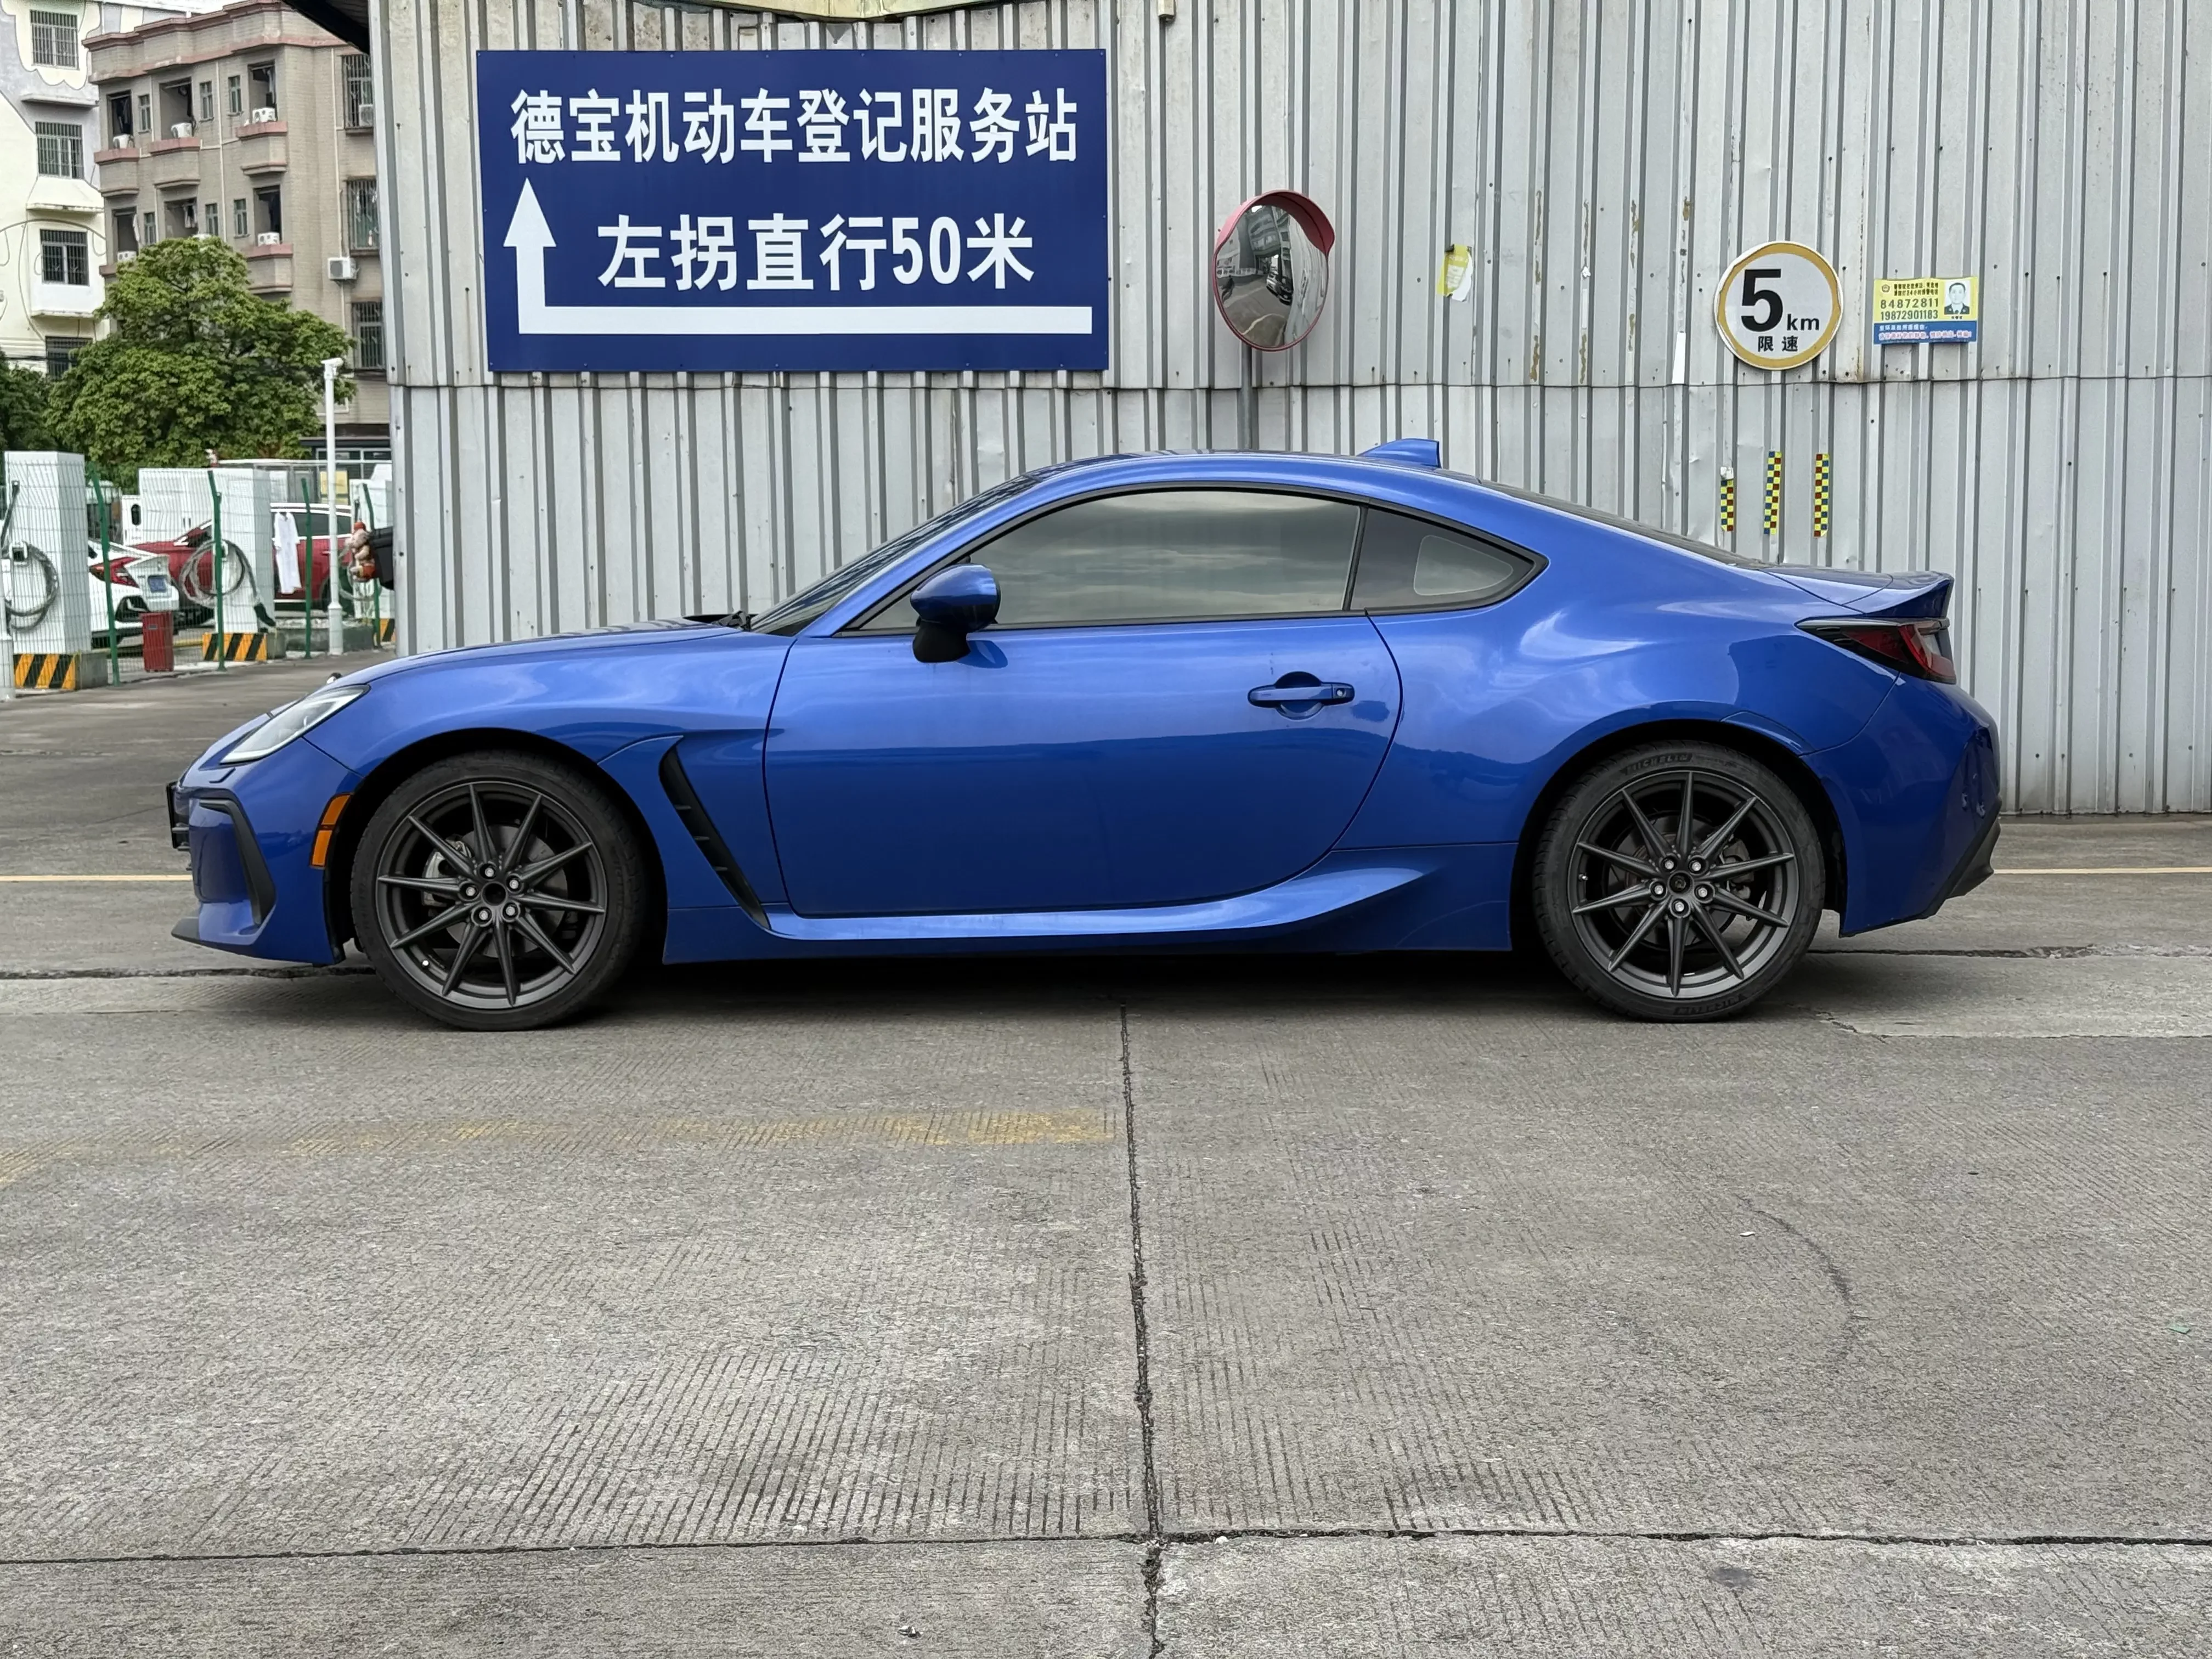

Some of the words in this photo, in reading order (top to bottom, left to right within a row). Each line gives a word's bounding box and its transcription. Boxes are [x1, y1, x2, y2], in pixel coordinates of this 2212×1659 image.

[511, 88, 1077, 163] 德宝机动车登记服务站
[597, 213, 1034, 291] 左拐直行50米
[1881, 298, 1938, 309] 84872811
[1881, 309, 1938, 320] 19872901183
[1758, 335, 1798, 352] 限速
